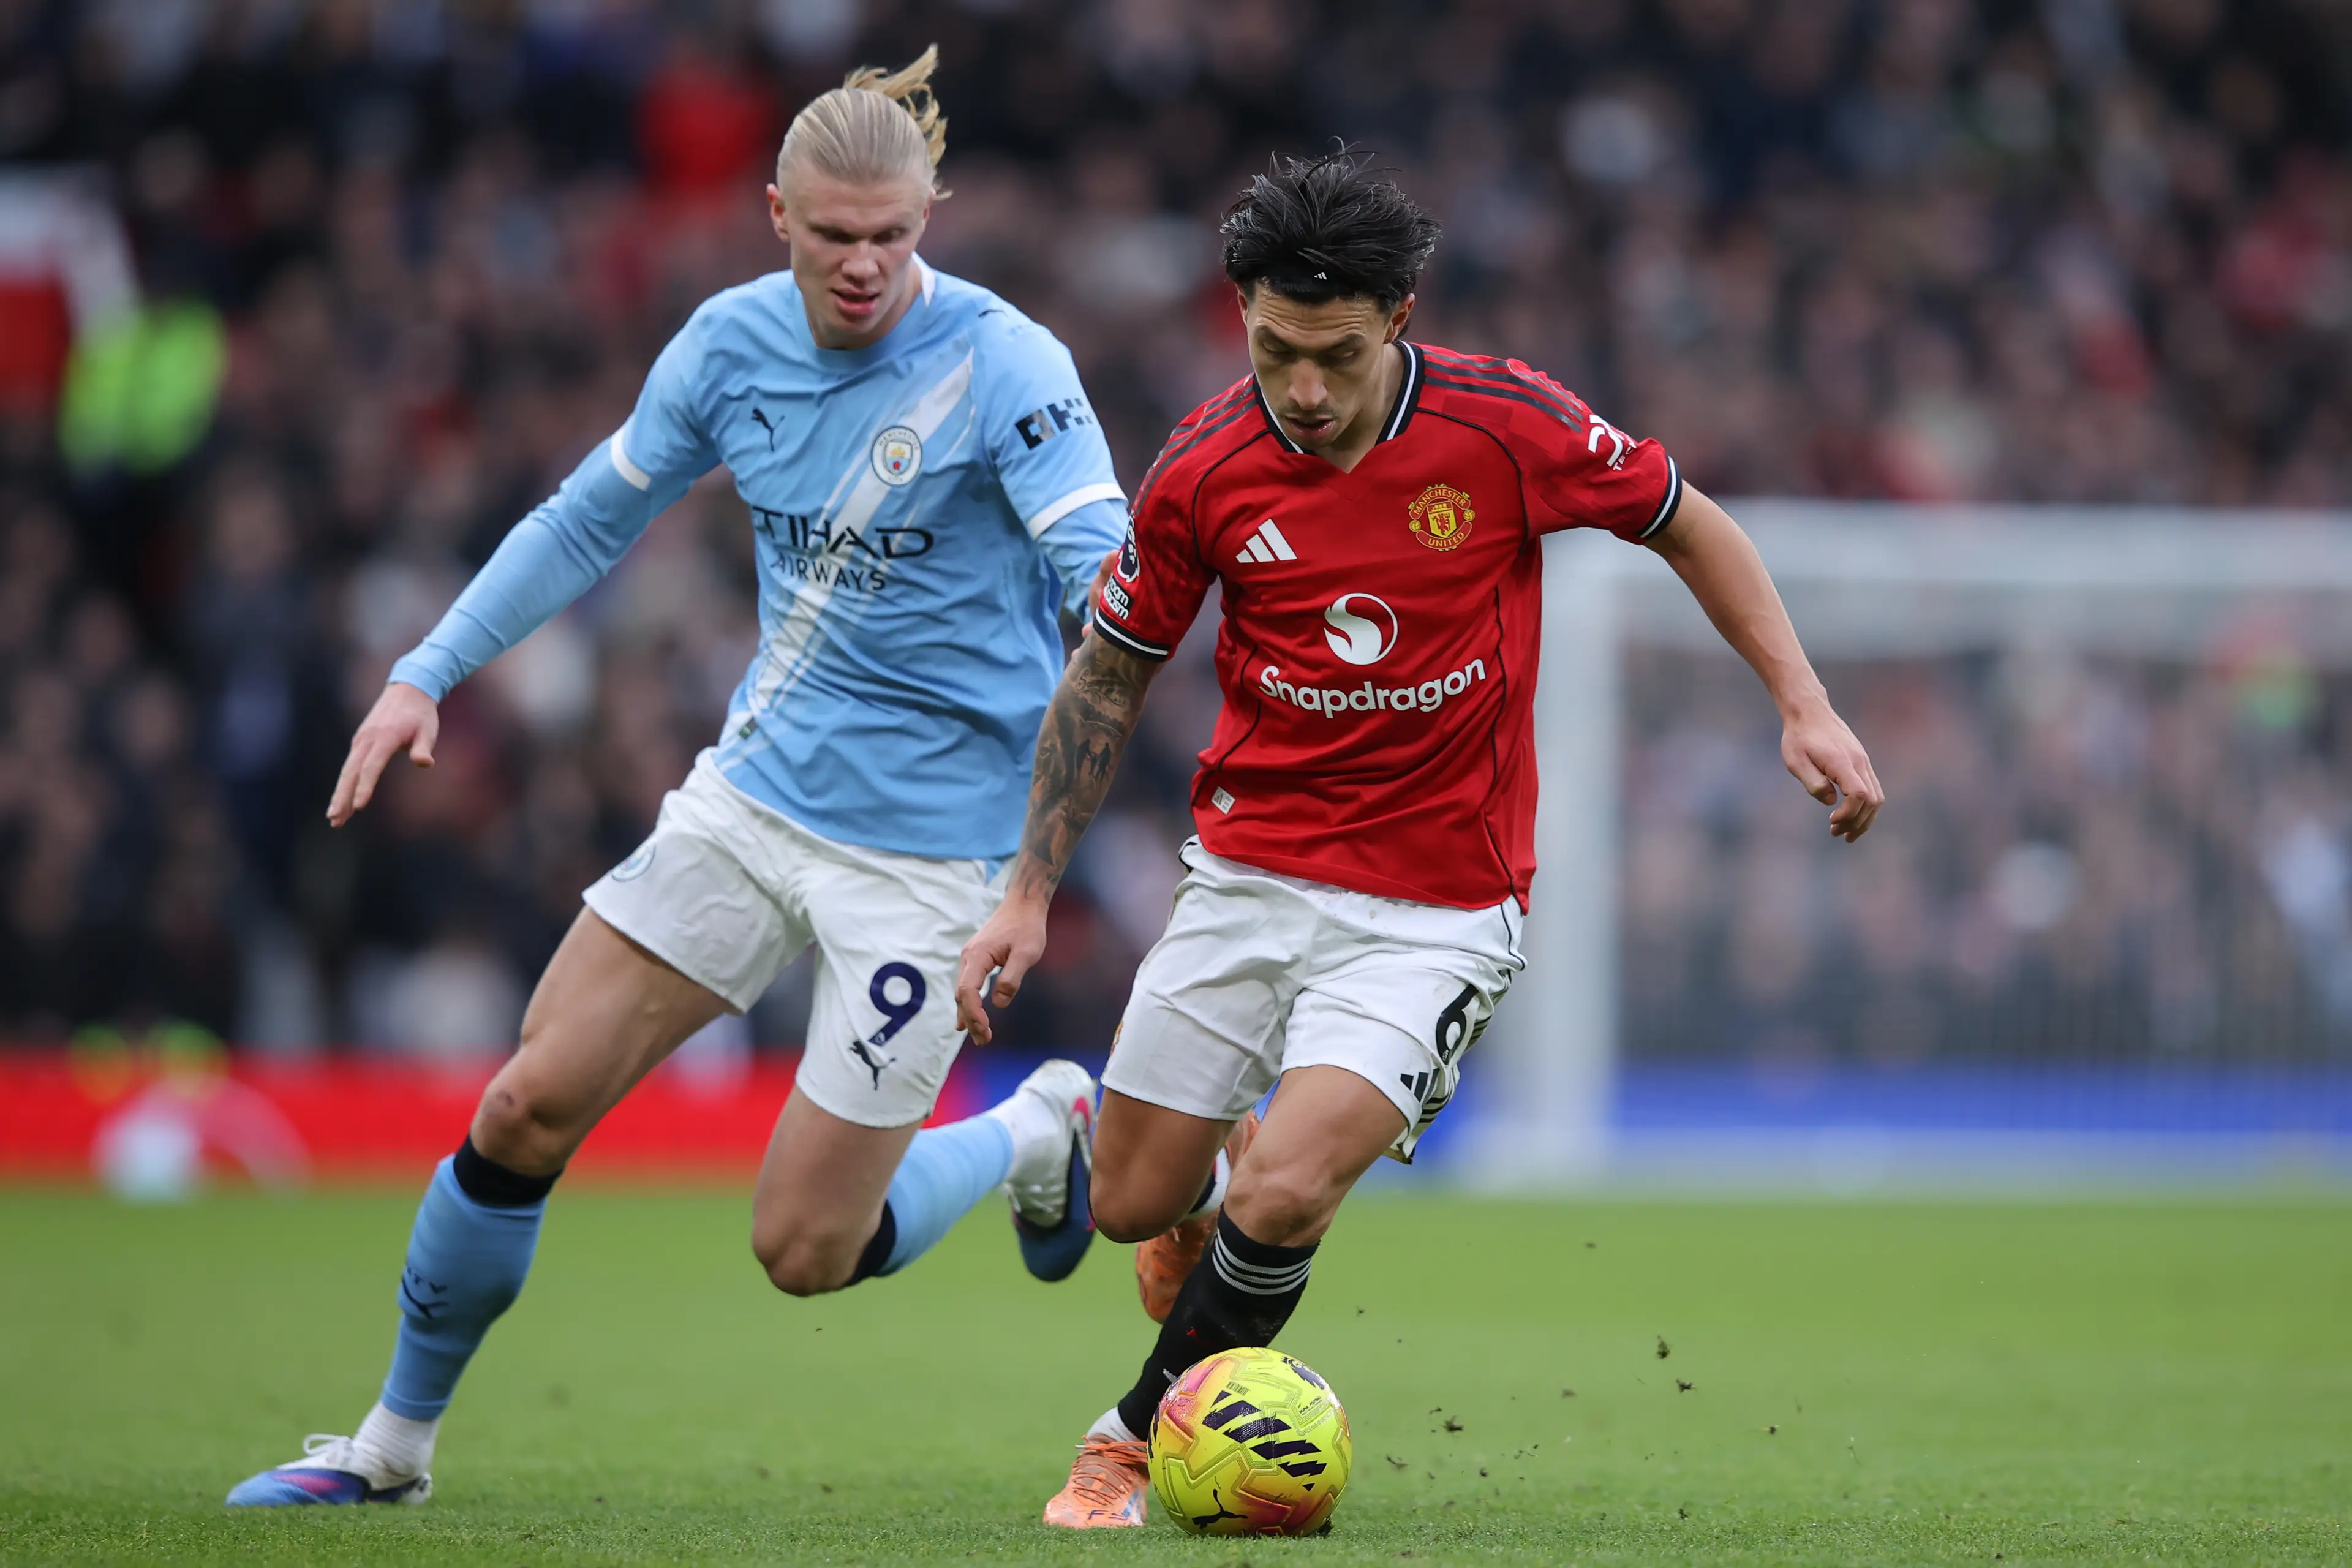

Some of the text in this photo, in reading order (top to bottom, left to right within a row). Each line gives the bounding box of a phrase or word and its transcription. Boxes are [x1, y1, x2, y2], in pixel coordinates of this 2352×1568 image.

[1413, 489, 1466, 515] MANCHESTER
[752, 505, 935, 560] TIHAD
[1428, 532, 1464, 547] UNITED
[769, 552, 886, 591] AIRWAYS
[1259, 658, 1486, 719] Snapdragon
[869, 961, 927, 1047] 9
[1435, 983, 1480, 1066] 6
